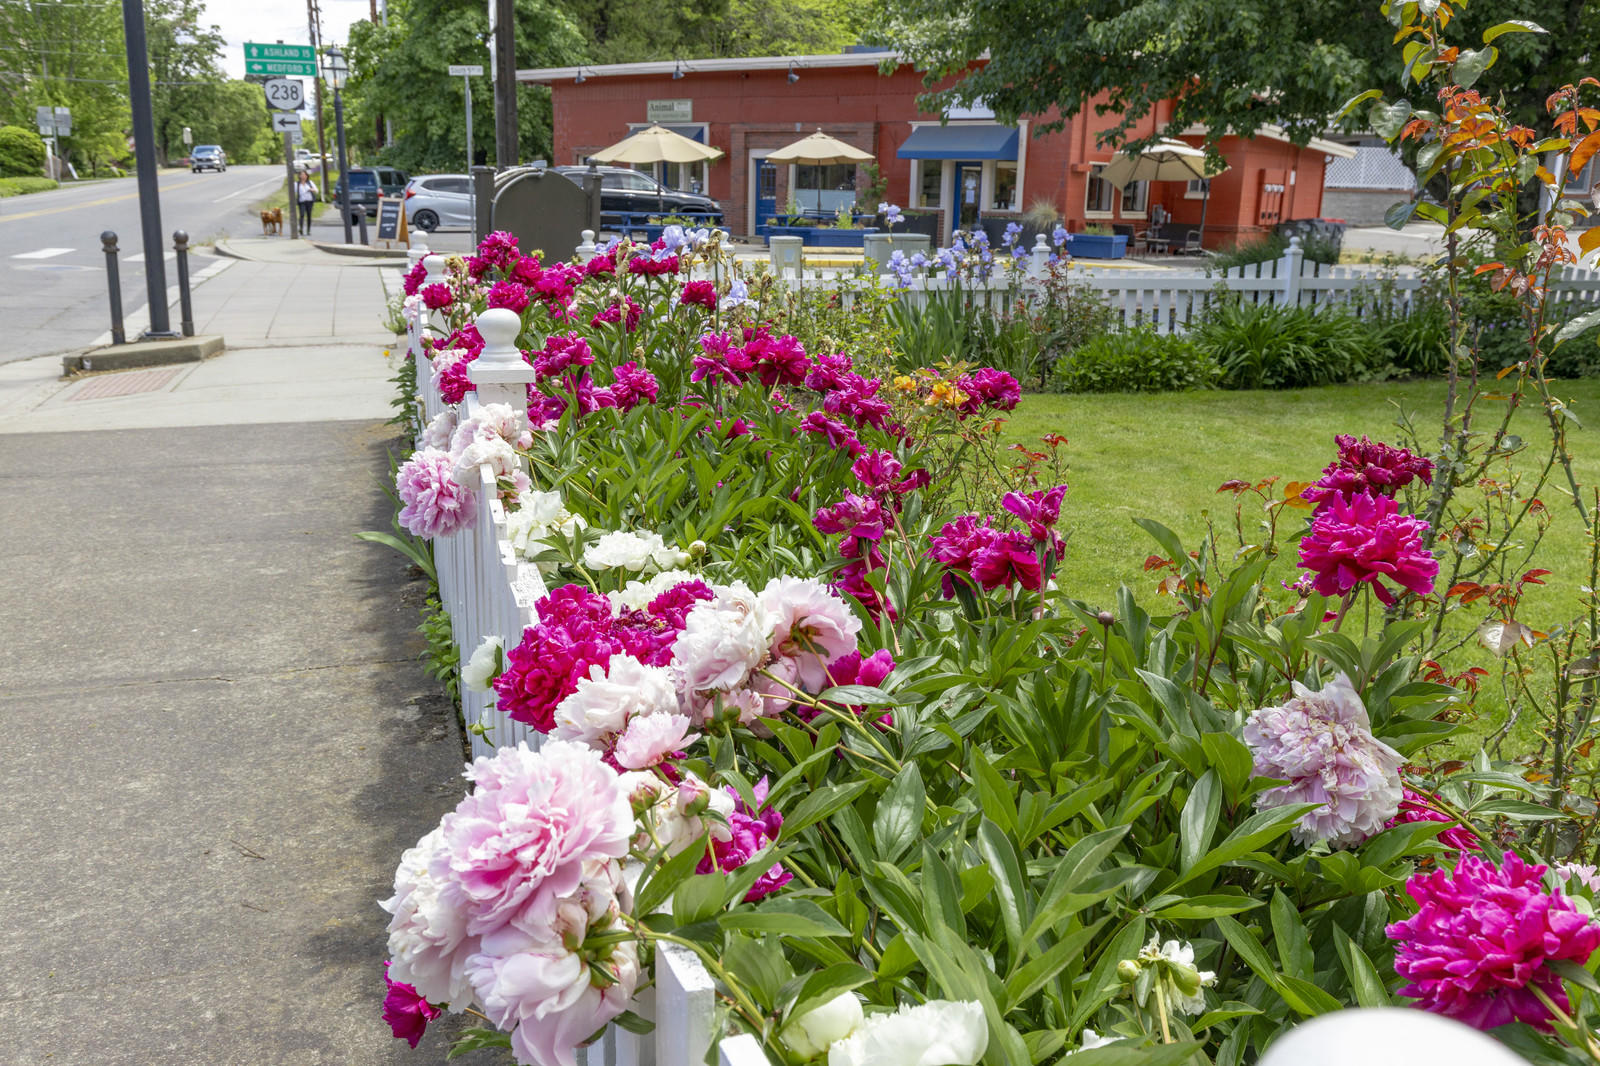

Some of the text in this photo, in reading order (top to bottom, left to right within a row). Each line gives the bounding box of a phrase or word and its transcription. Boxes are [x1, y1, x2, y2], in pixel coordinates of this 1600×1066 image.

[263, 47, 311, 58] ASHLAND 15
[266, 63, 312, 74] MEDFORD 5
[270, 84, 299, 101] 238
[649, 101, 675, 112] Animal
